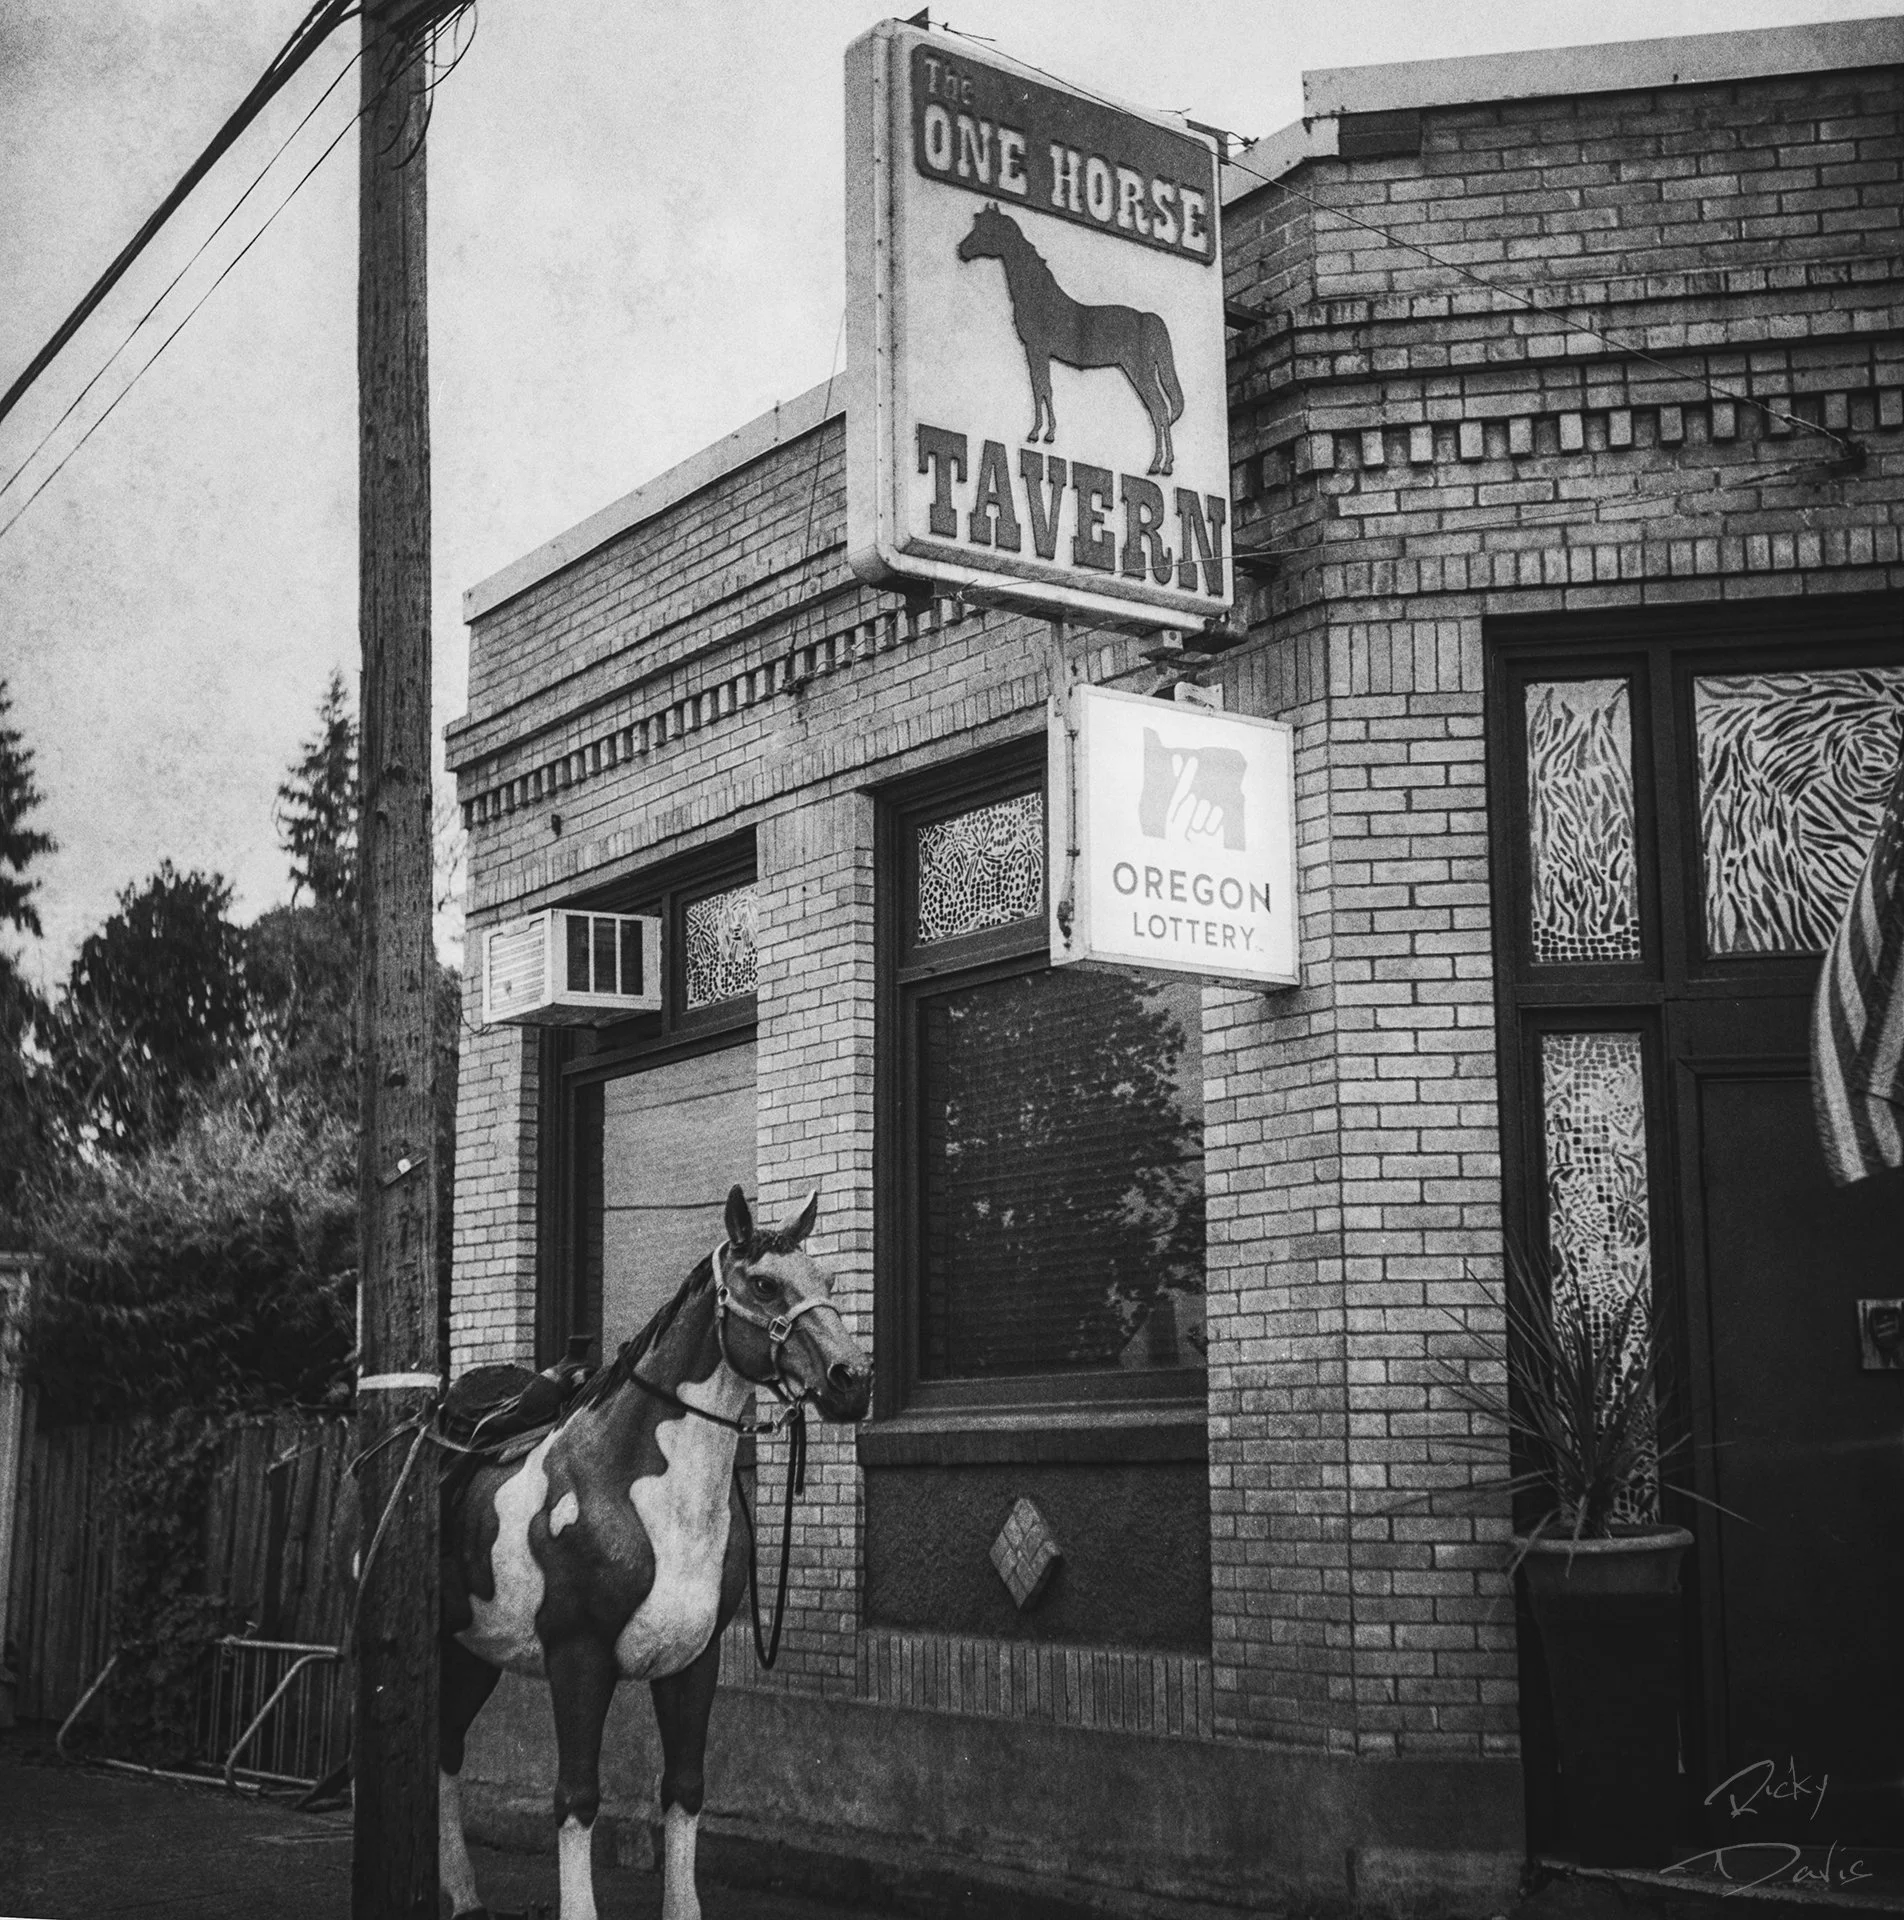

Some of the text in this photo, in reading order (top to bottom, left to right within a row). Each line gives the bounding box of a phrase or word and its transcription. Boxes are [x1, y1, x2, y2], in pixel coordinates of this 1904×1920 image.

[924, 104, 1209, 254] ONE HORSE
[917, 423, 1226, 597] TAVERN
[1113, 861, 1271, 914] OREGON
[1133, 911, 1256, 951] LOTTERY
